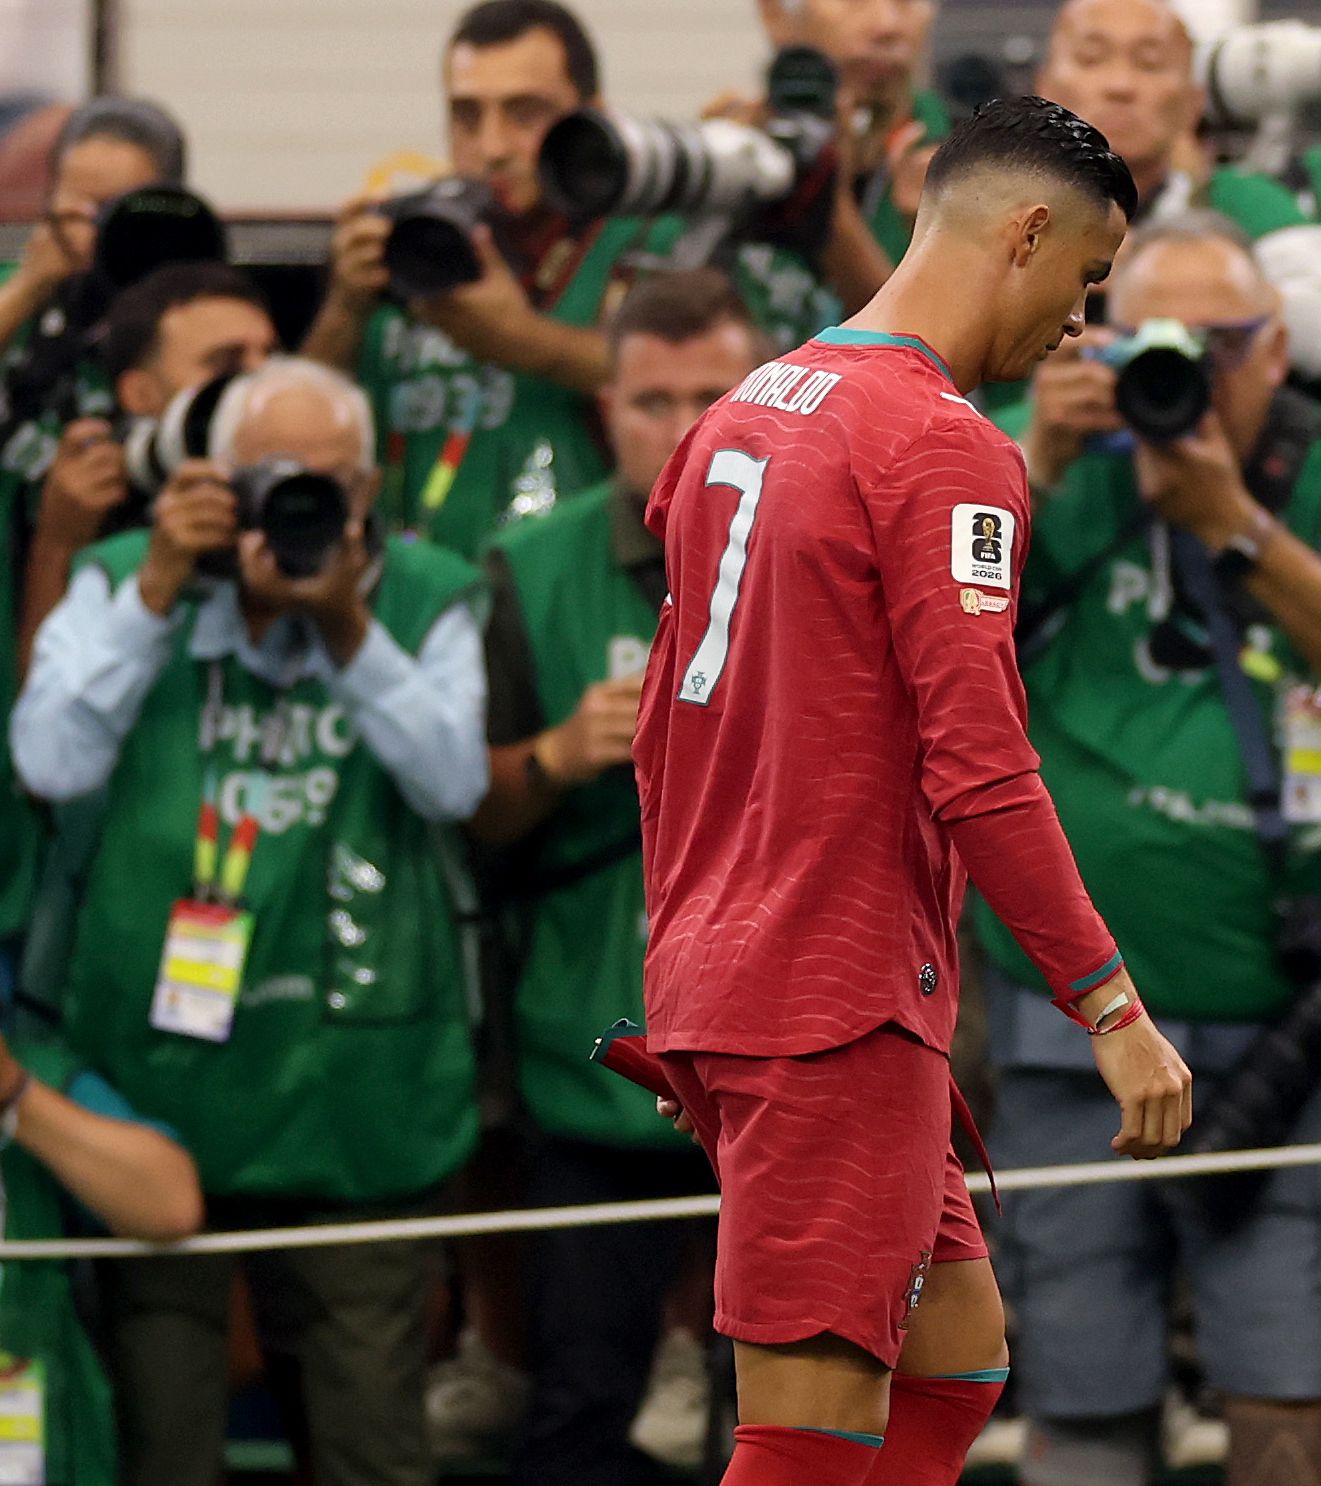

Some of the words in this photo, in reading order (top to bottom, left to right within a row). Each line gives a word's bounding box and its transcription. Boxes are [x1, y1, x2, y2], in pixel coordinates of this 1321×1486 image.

[729, 361, 843, 415] RONALDO
[676, 448, 772, 706] 7
[971, 569, 1002, 580] 2026
